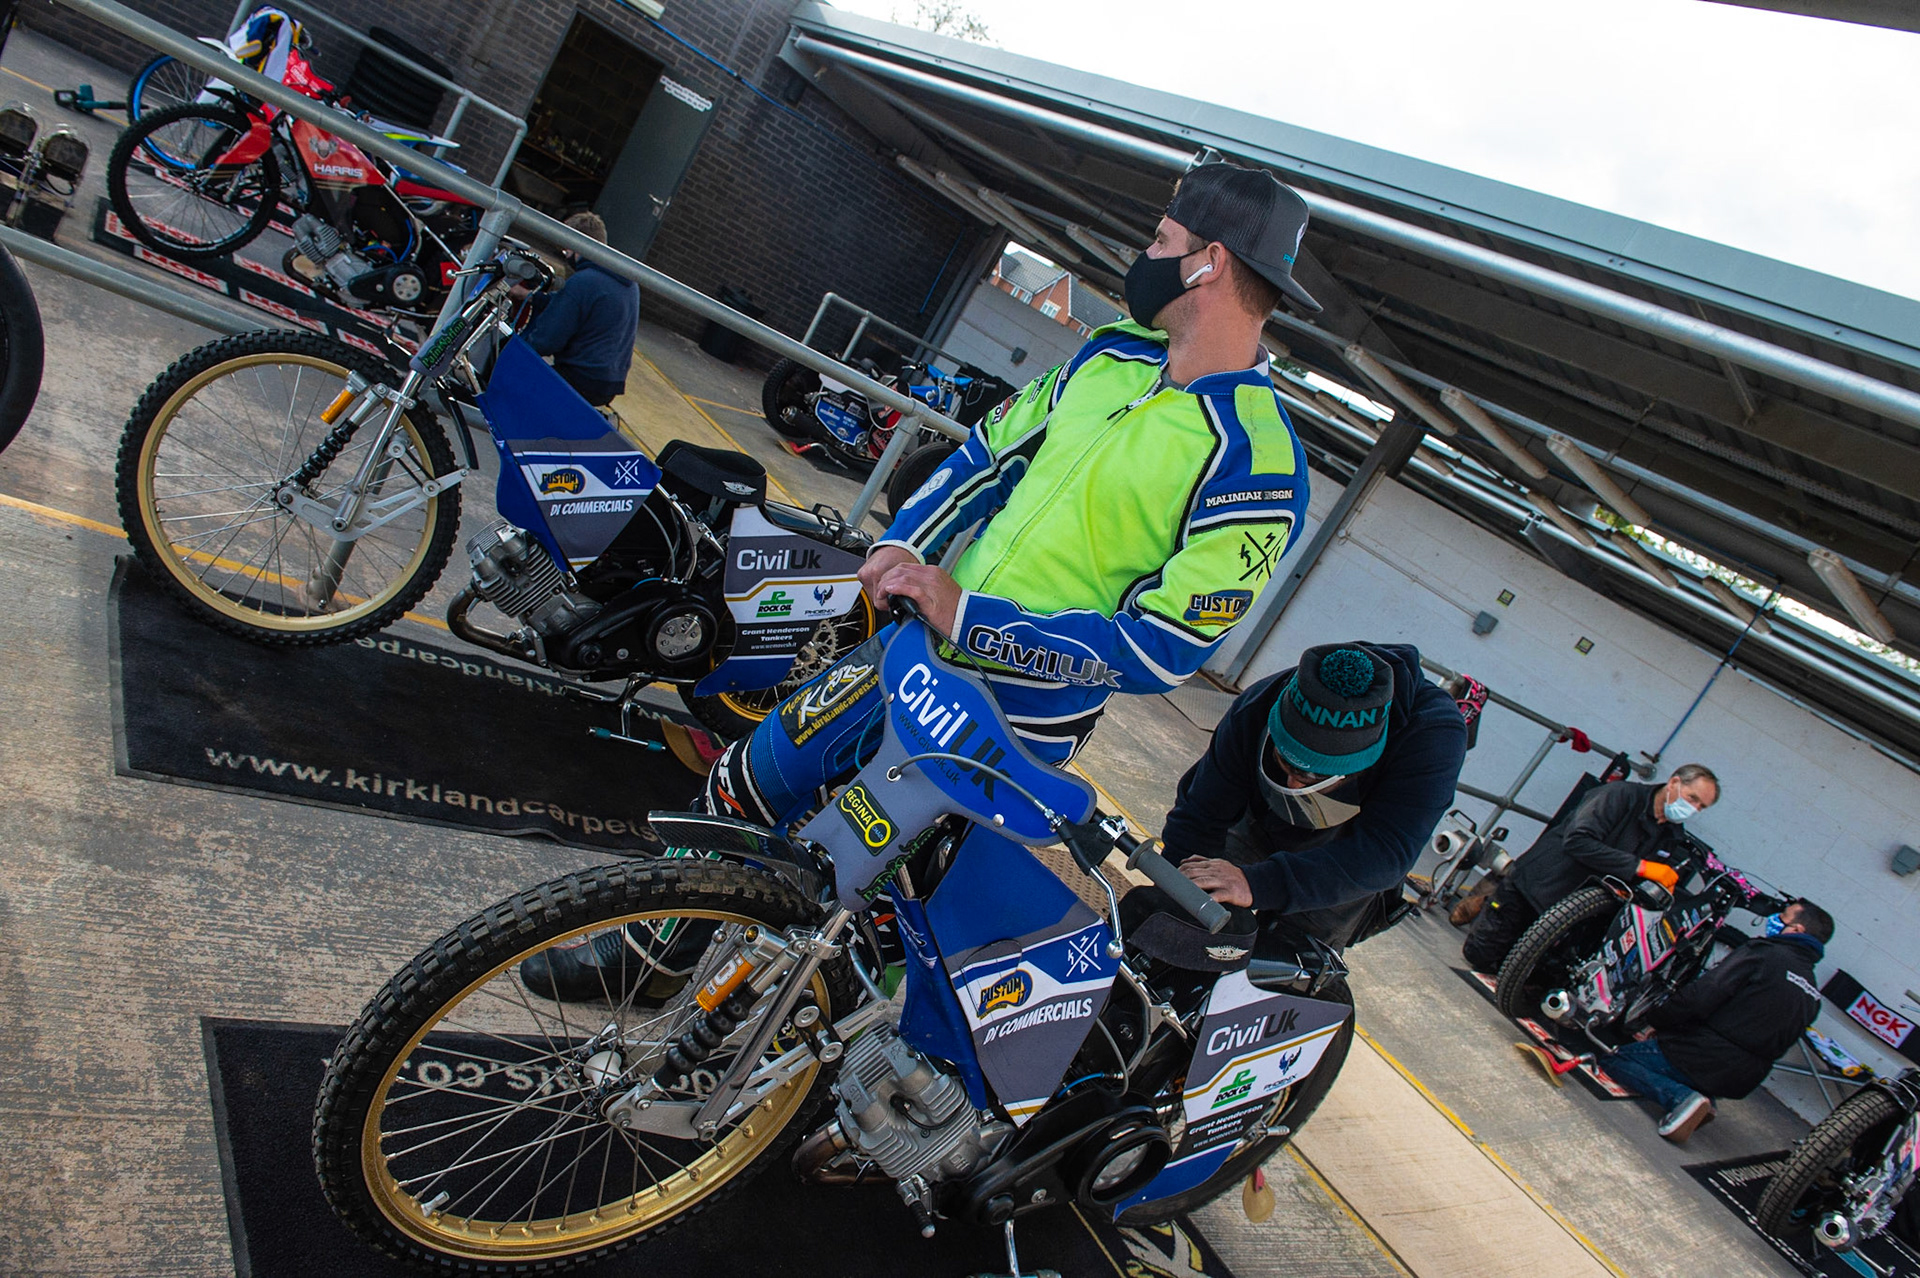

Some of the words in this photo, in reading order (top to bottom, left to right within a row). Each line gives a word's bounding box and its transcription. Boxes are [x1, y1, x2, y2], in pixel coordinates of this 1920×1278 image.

[314, 163, 363, 178] HARRIS
[561, 499, 633, 515] COMMERCIALS
[736, 549, 822, 570] CivilUk
[766, 626, 810, 634] Henderson
[781, 687, 812, 716] Team
[845, 789, 872, 826] REGINA
[998, 997, 1092, 1039] COMMERCIALS
[1856, 995, 1908, 1038] NGK
[1206, 1008, 1300, 1056] CivilUk
[1189, 1120, 1216, 1135] Grant
[1215, 1103, 1264, 1125] Henderson
[1207, 1118, 1242, 1135] Tankers
